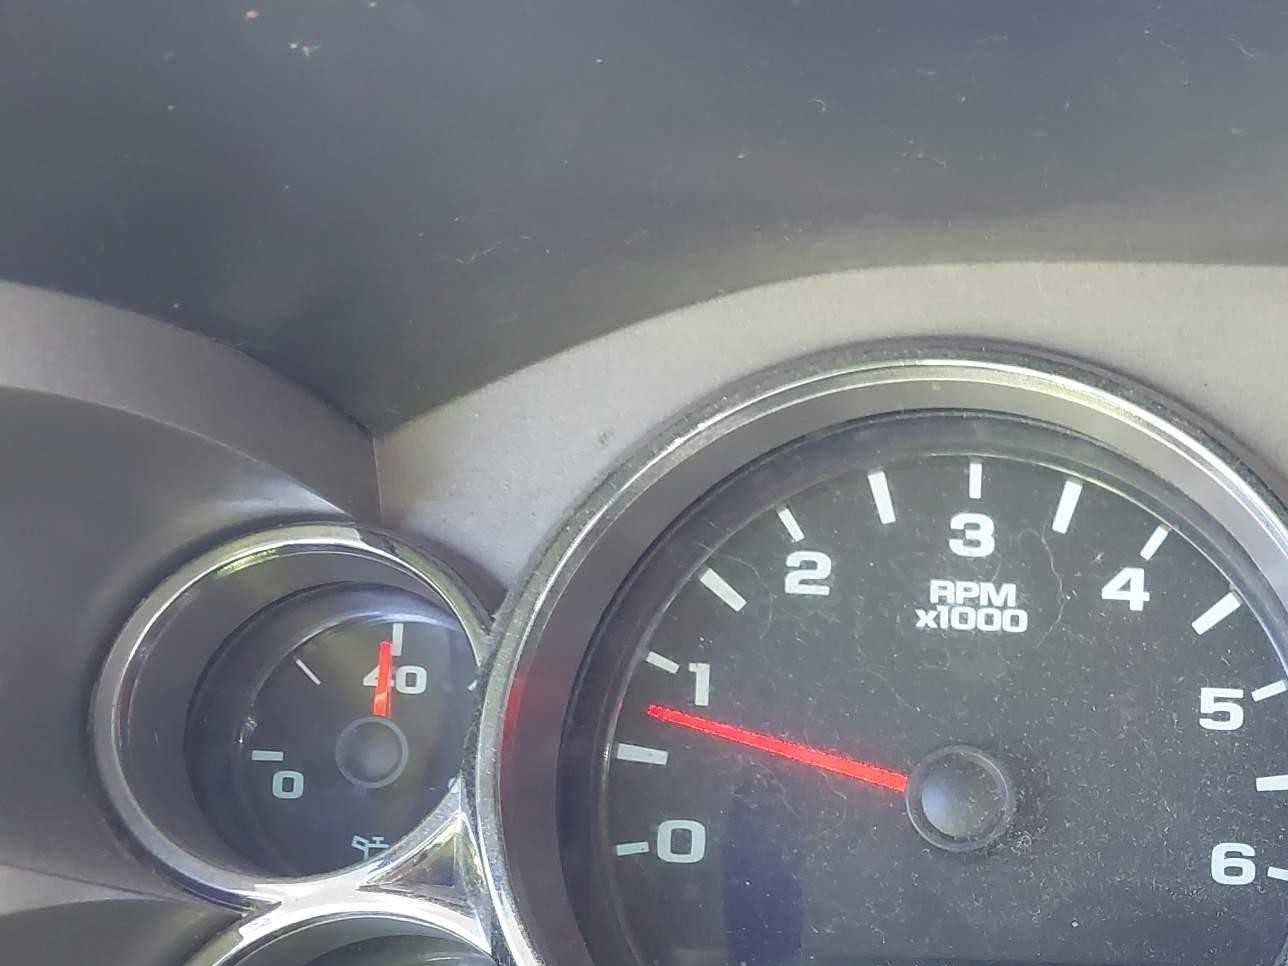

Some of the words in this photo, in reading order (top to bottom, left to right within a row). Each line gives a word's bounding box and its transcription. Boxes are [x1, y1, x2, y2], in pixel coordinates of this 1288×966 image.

[948, 513, 995, 557] 3
[784, 551, 831, 596] 2
[929, 579, 1017, 607] RPM
[1101, 567, 1150, 611] 4
[915, 607, 1028, 633] x1000
[687, 662, 711, 705] 1
[1200, 687, 1245, 731] 5
[272, 770, 304, 799] 0
[656, 819, 706, 864] 0
[1210, 843, 1256, 886] 6
